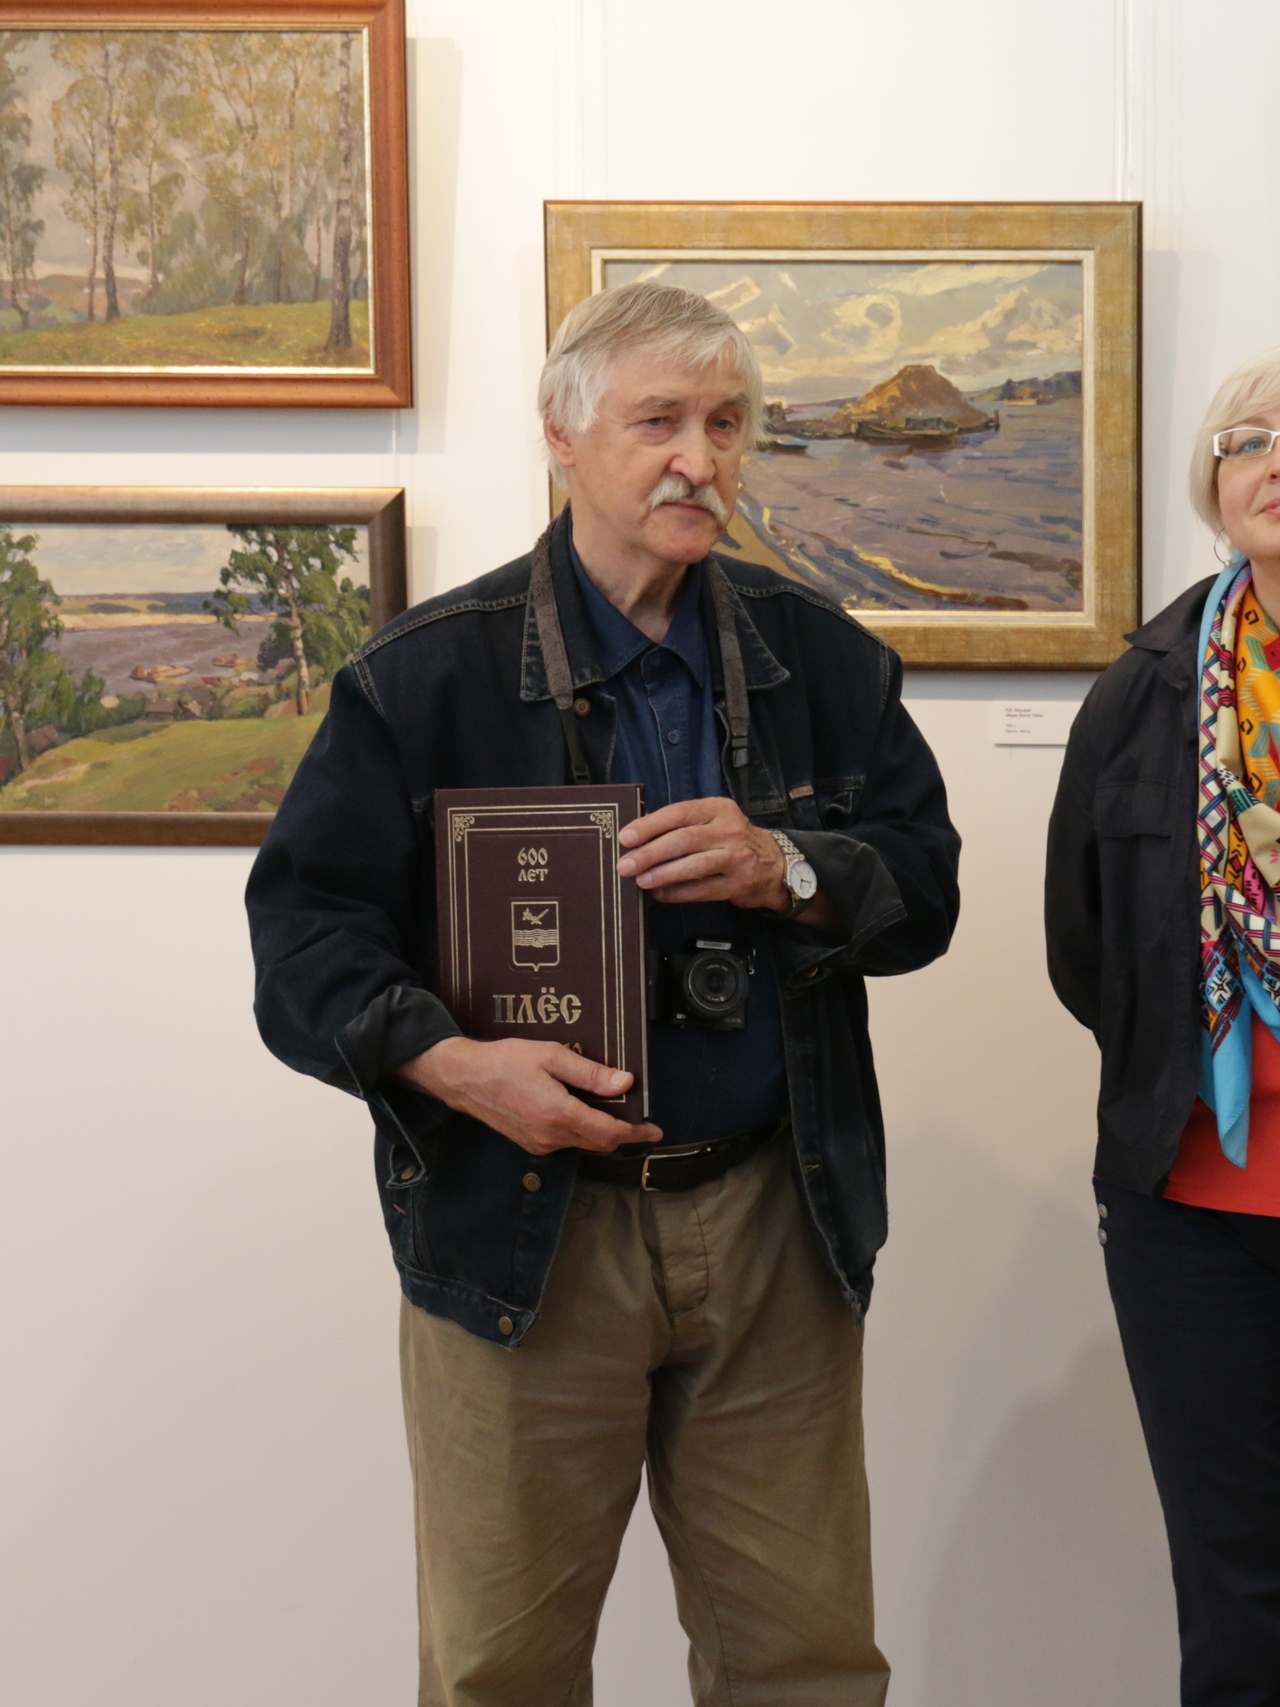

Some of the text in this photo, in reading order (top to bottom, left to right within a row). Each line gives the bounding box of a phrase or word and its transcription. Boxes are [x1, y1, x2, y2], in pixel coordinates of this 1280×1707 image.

[517, 847, 548, 866] 600
[518, 868, 548, 882] ЛЕТ
[492, 987, 582, 1024] ПЛЁС
